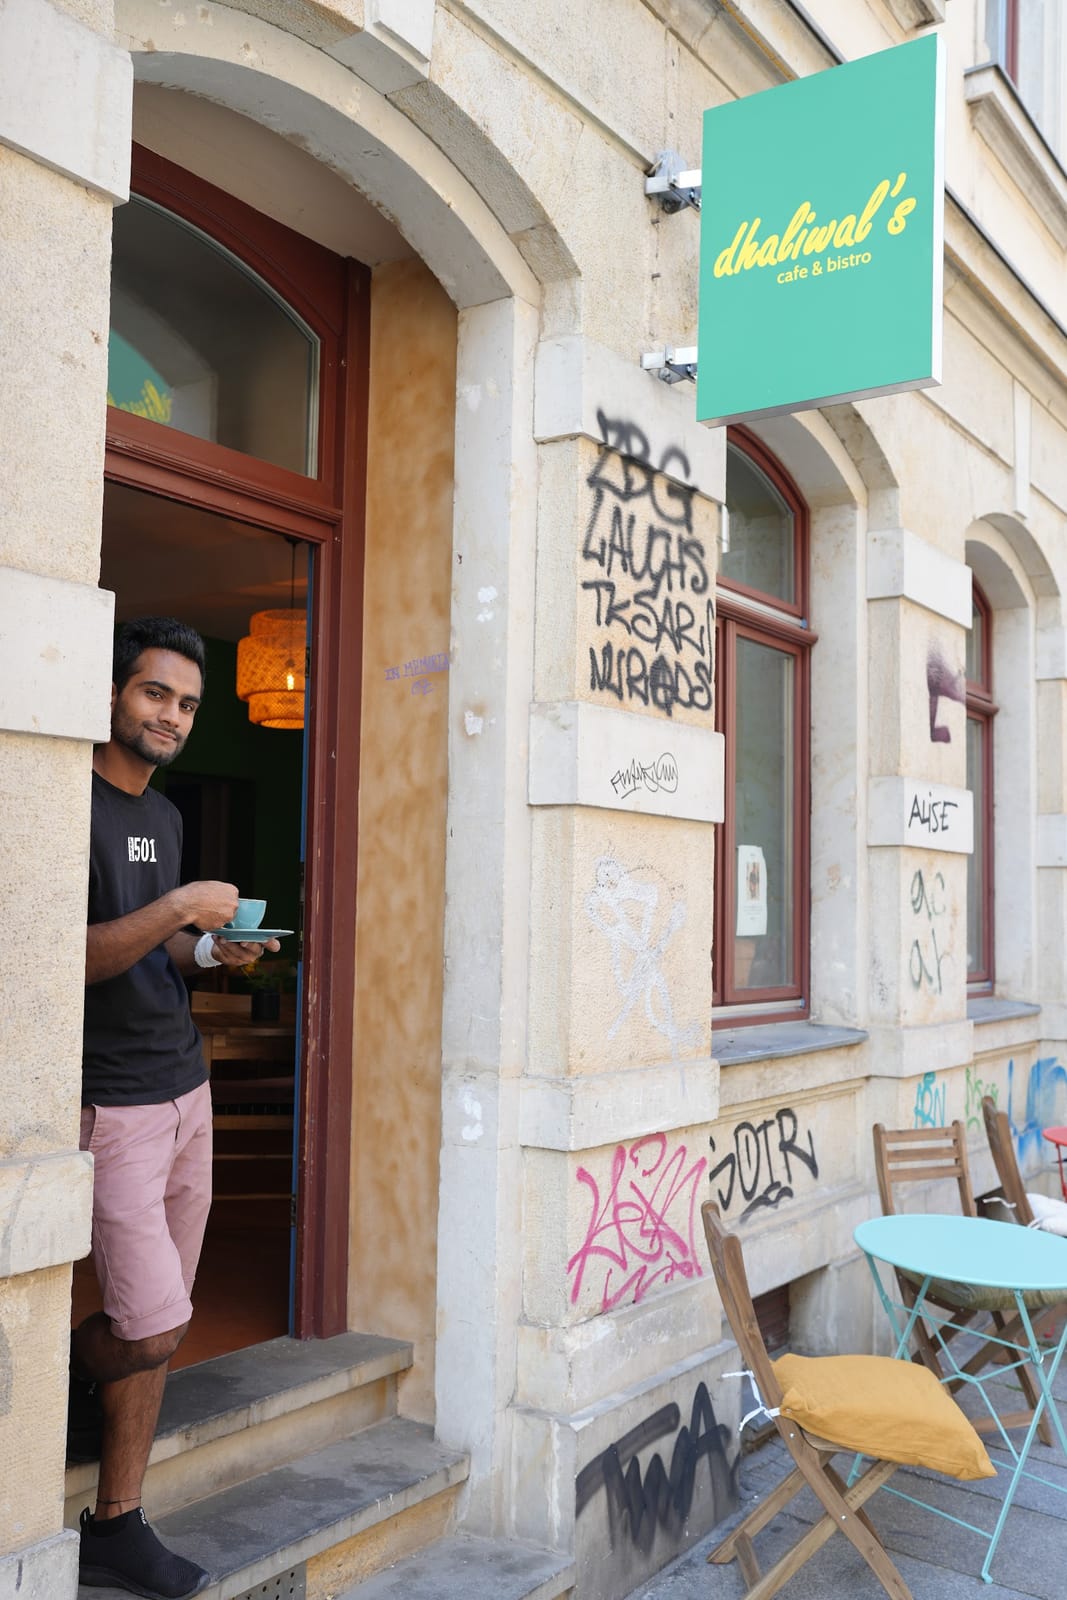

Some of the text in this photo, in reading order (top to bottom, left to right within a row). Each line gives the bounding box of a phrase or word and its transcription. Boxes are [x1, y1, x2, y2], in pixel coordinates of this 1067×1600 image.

[713, 172, 916, 278] dhaliwal's
[776, 252, 872, 284] cafe & bistro
